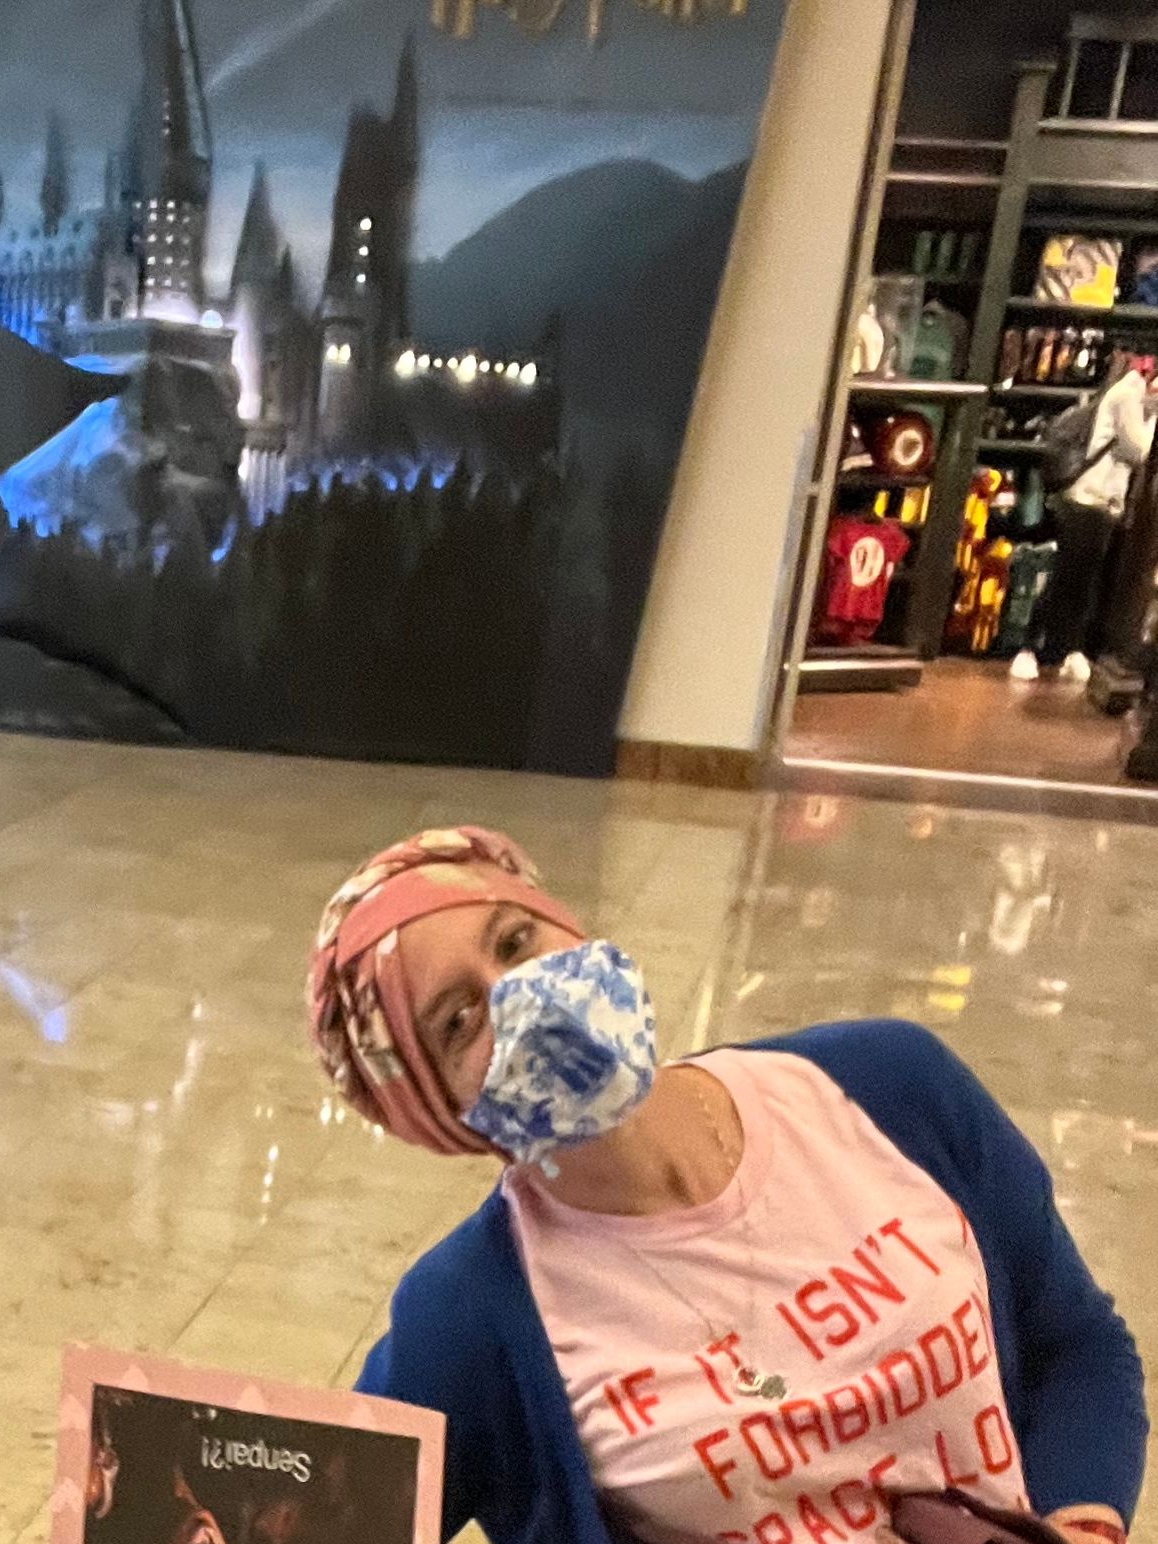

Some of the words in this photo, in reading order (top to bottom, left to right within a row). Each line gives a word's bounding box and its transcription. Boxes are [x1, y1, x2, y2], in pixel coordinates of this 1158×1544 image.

[603, 1367, 660, 1437] IF
[776, 1218, 942, 1362] ISN'T
[200, 1435, 312, 1484] Senpai?!
